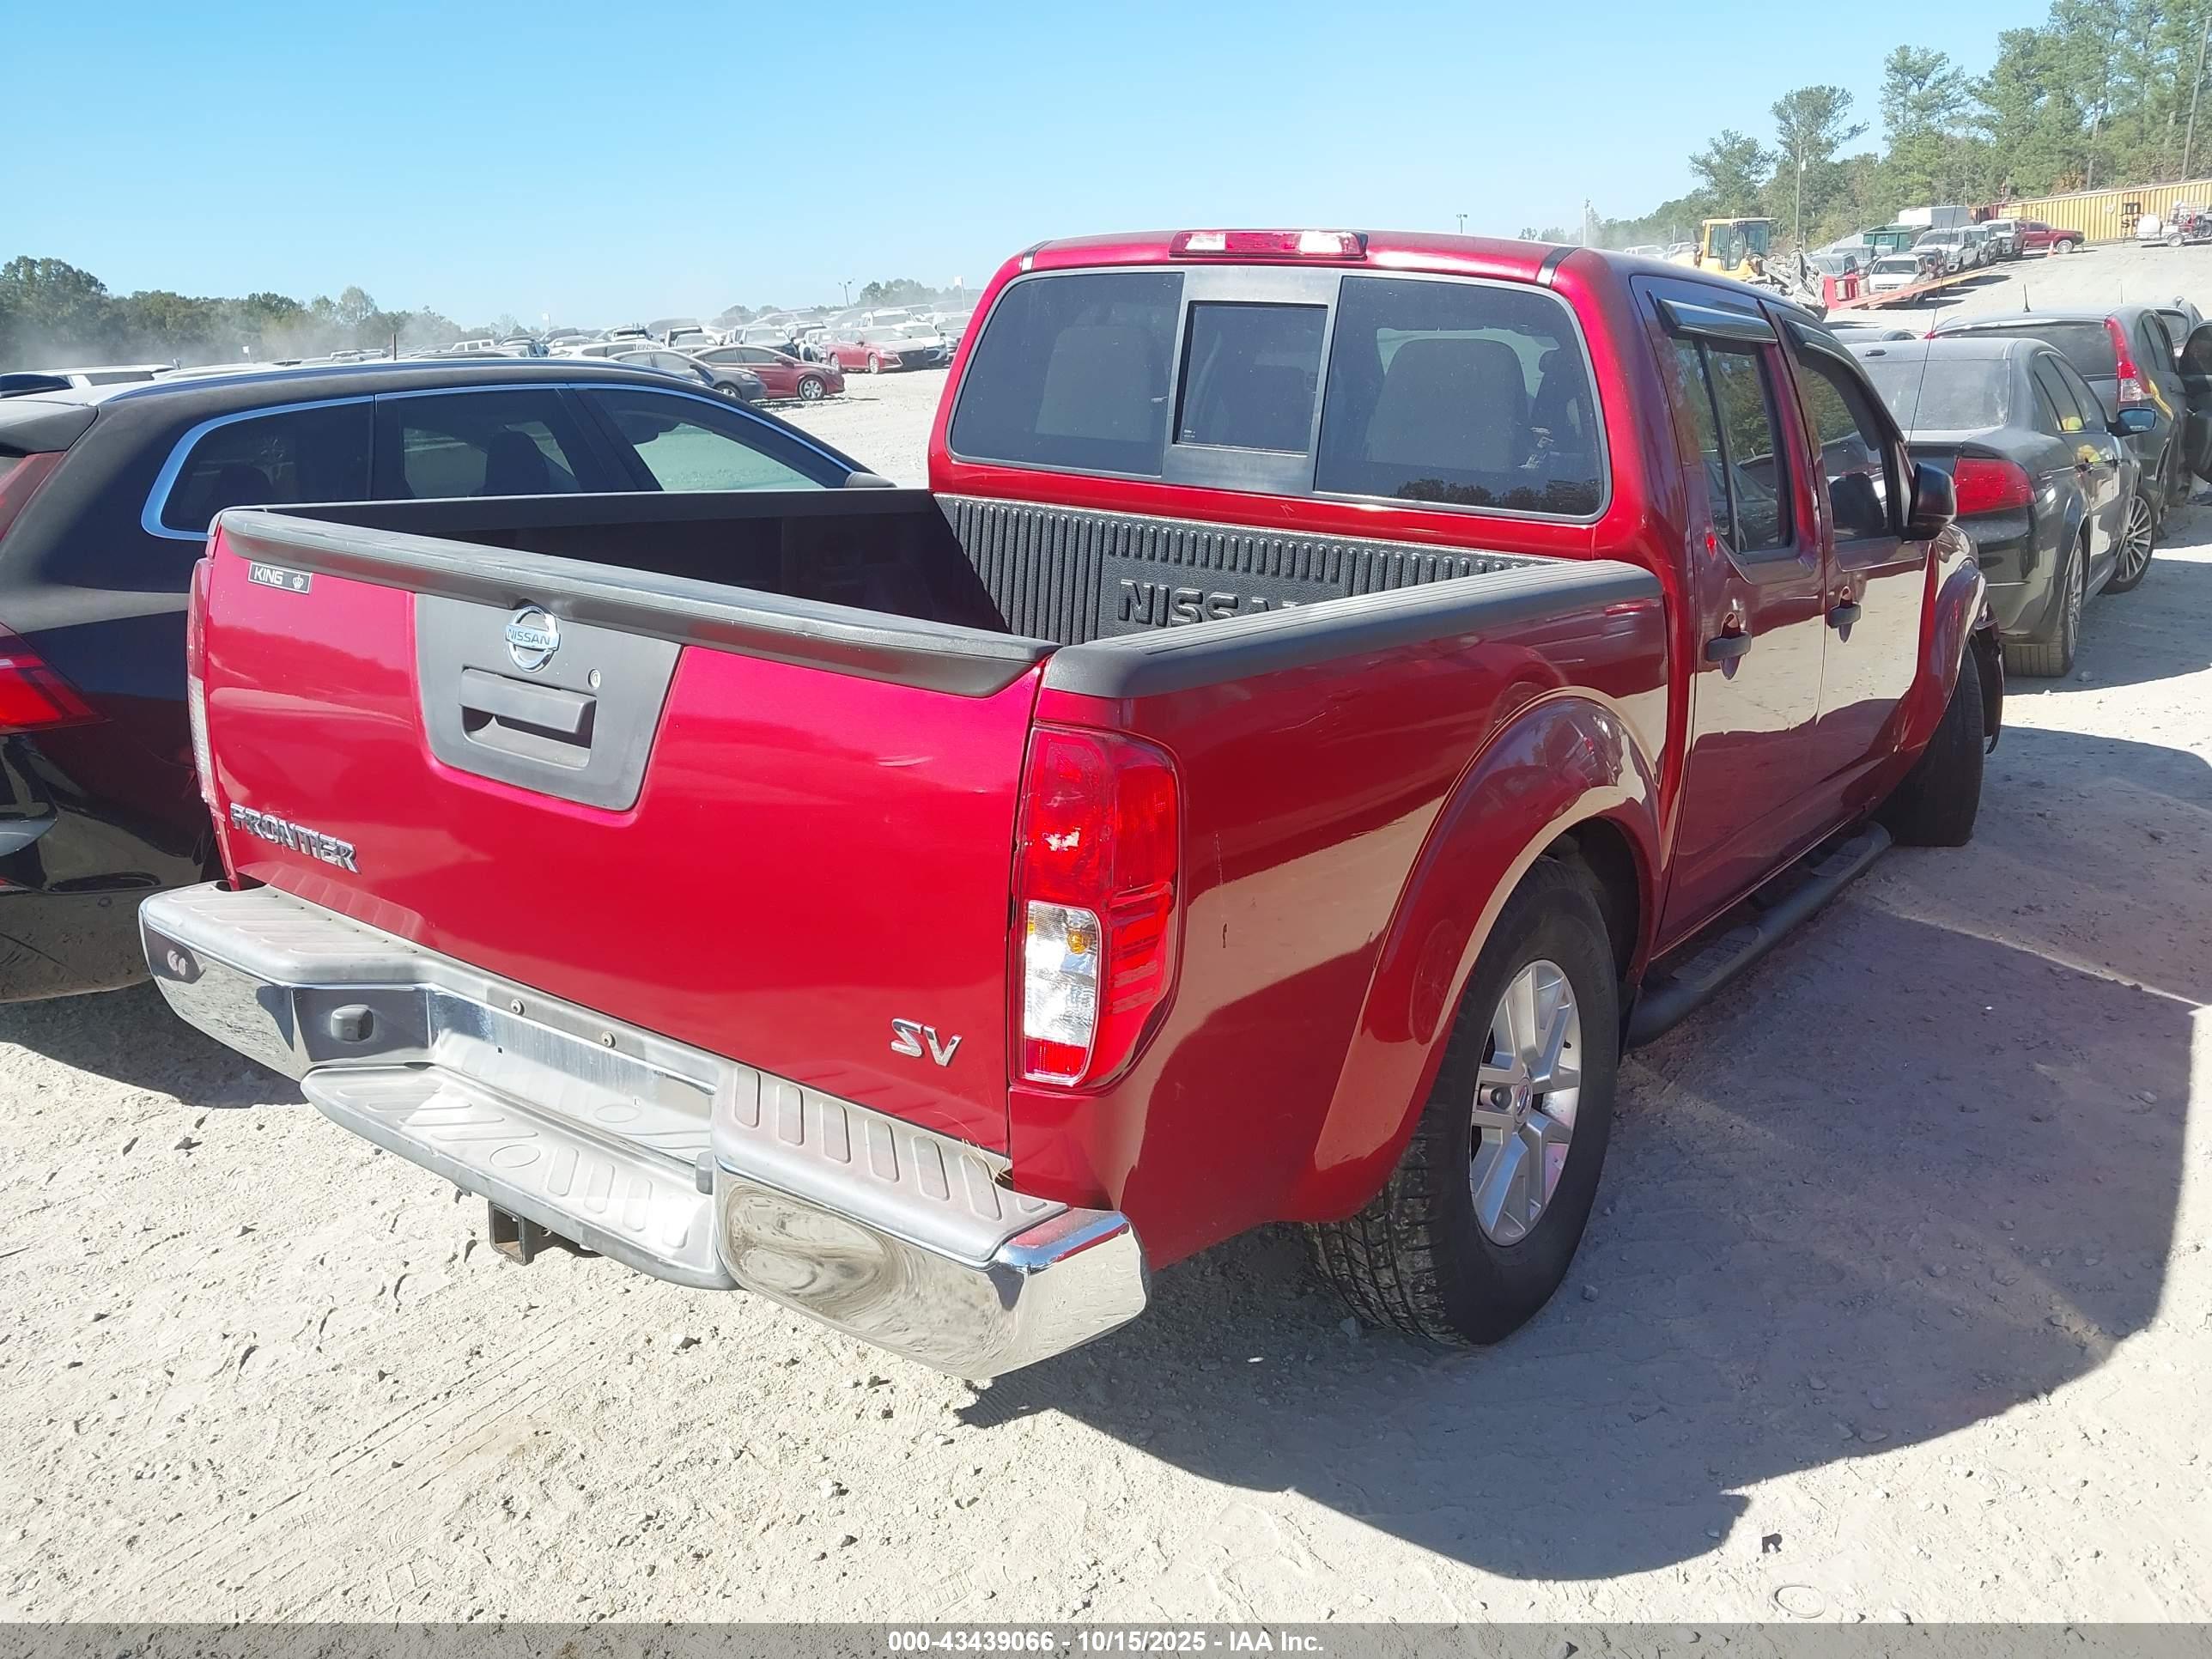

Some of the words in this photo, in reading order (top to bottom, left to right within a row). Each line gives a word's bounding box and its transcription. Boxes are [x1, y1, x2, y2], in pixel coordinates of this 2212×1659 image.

[253, 566, 284, 585] KING
[1118, 579, 1299, 628] NISS
[507, 629, 550, 646] NISSAN
[229, 802, 361, 874] FRONTIER
[890, 1018, 962, 1066] SV
